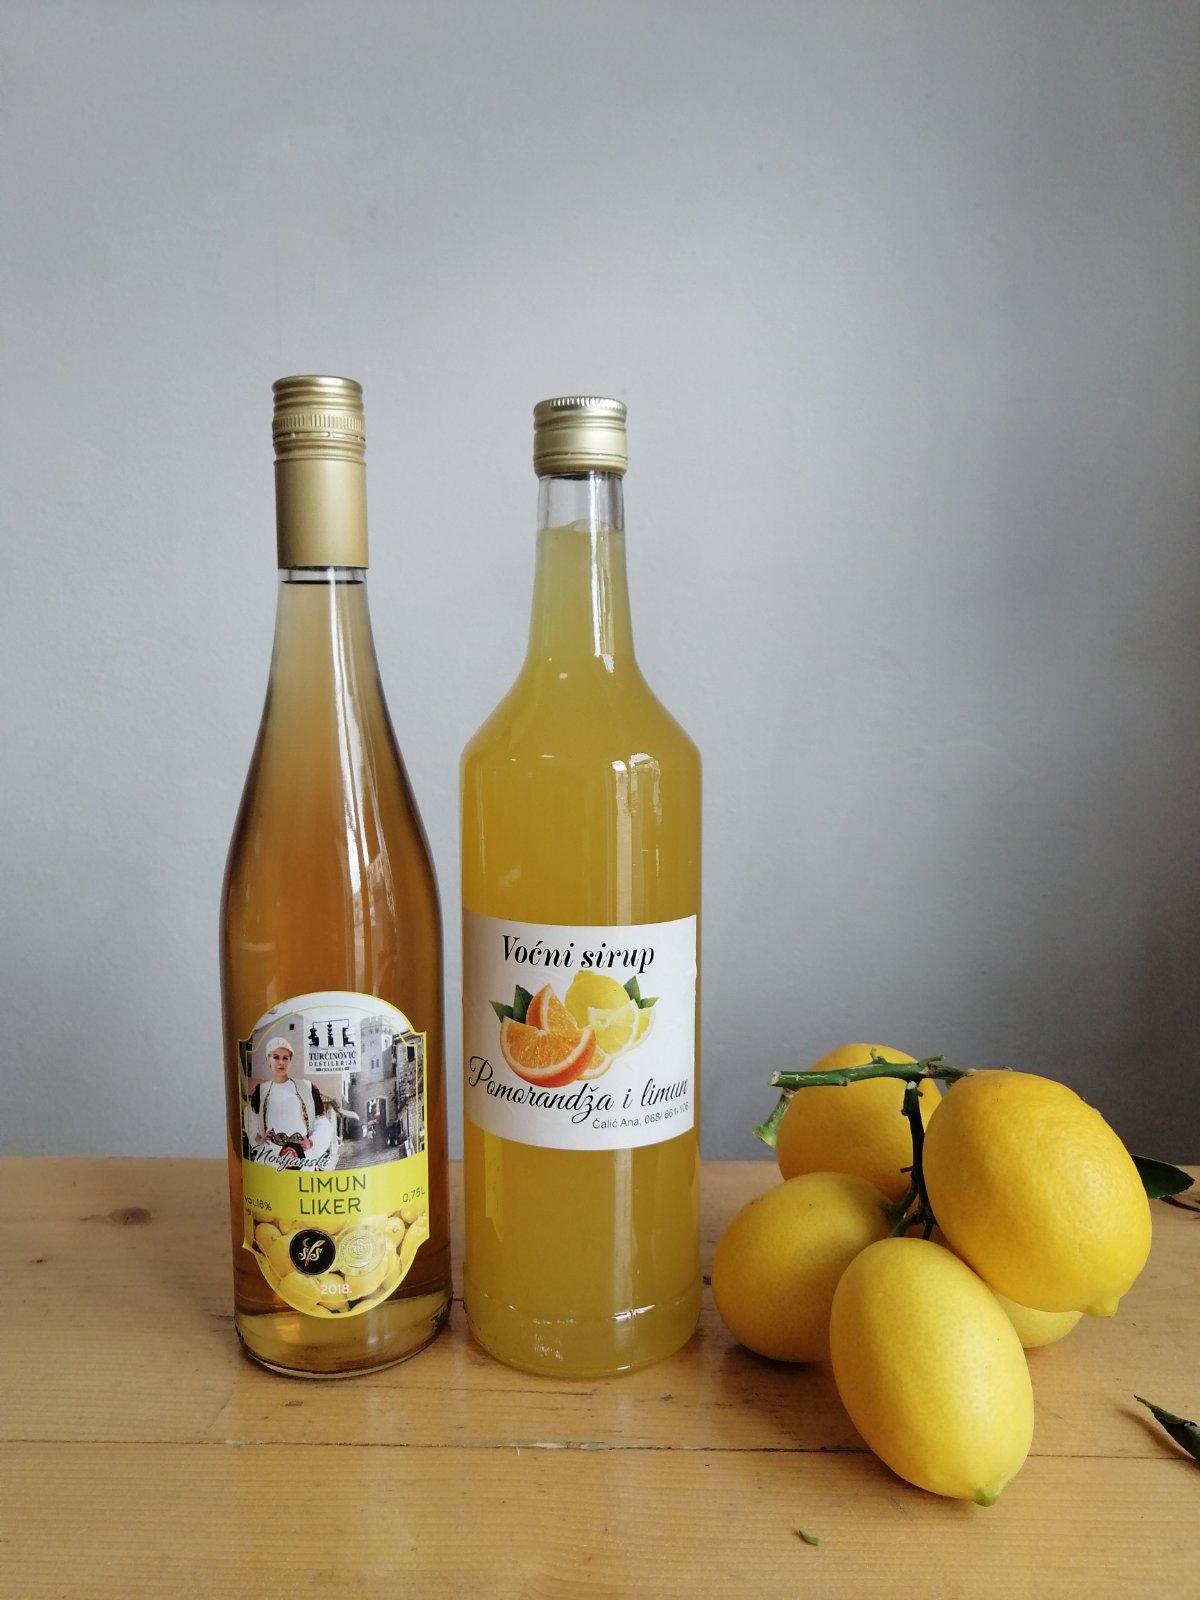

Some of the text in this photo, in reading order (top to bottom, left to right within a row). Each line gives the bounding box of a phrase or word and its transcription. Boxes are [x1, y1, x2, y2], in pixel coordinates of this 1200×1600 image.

[502, 934, 655, 974] Voćni sirup
[468, 1056, 689, 1124] Pomorandža i limun
[620, 1118, 642, 1128] Ana,
[298, 1173, 367, 1194] LIMUN
[299, 1197, 362, 1215] LIKER
